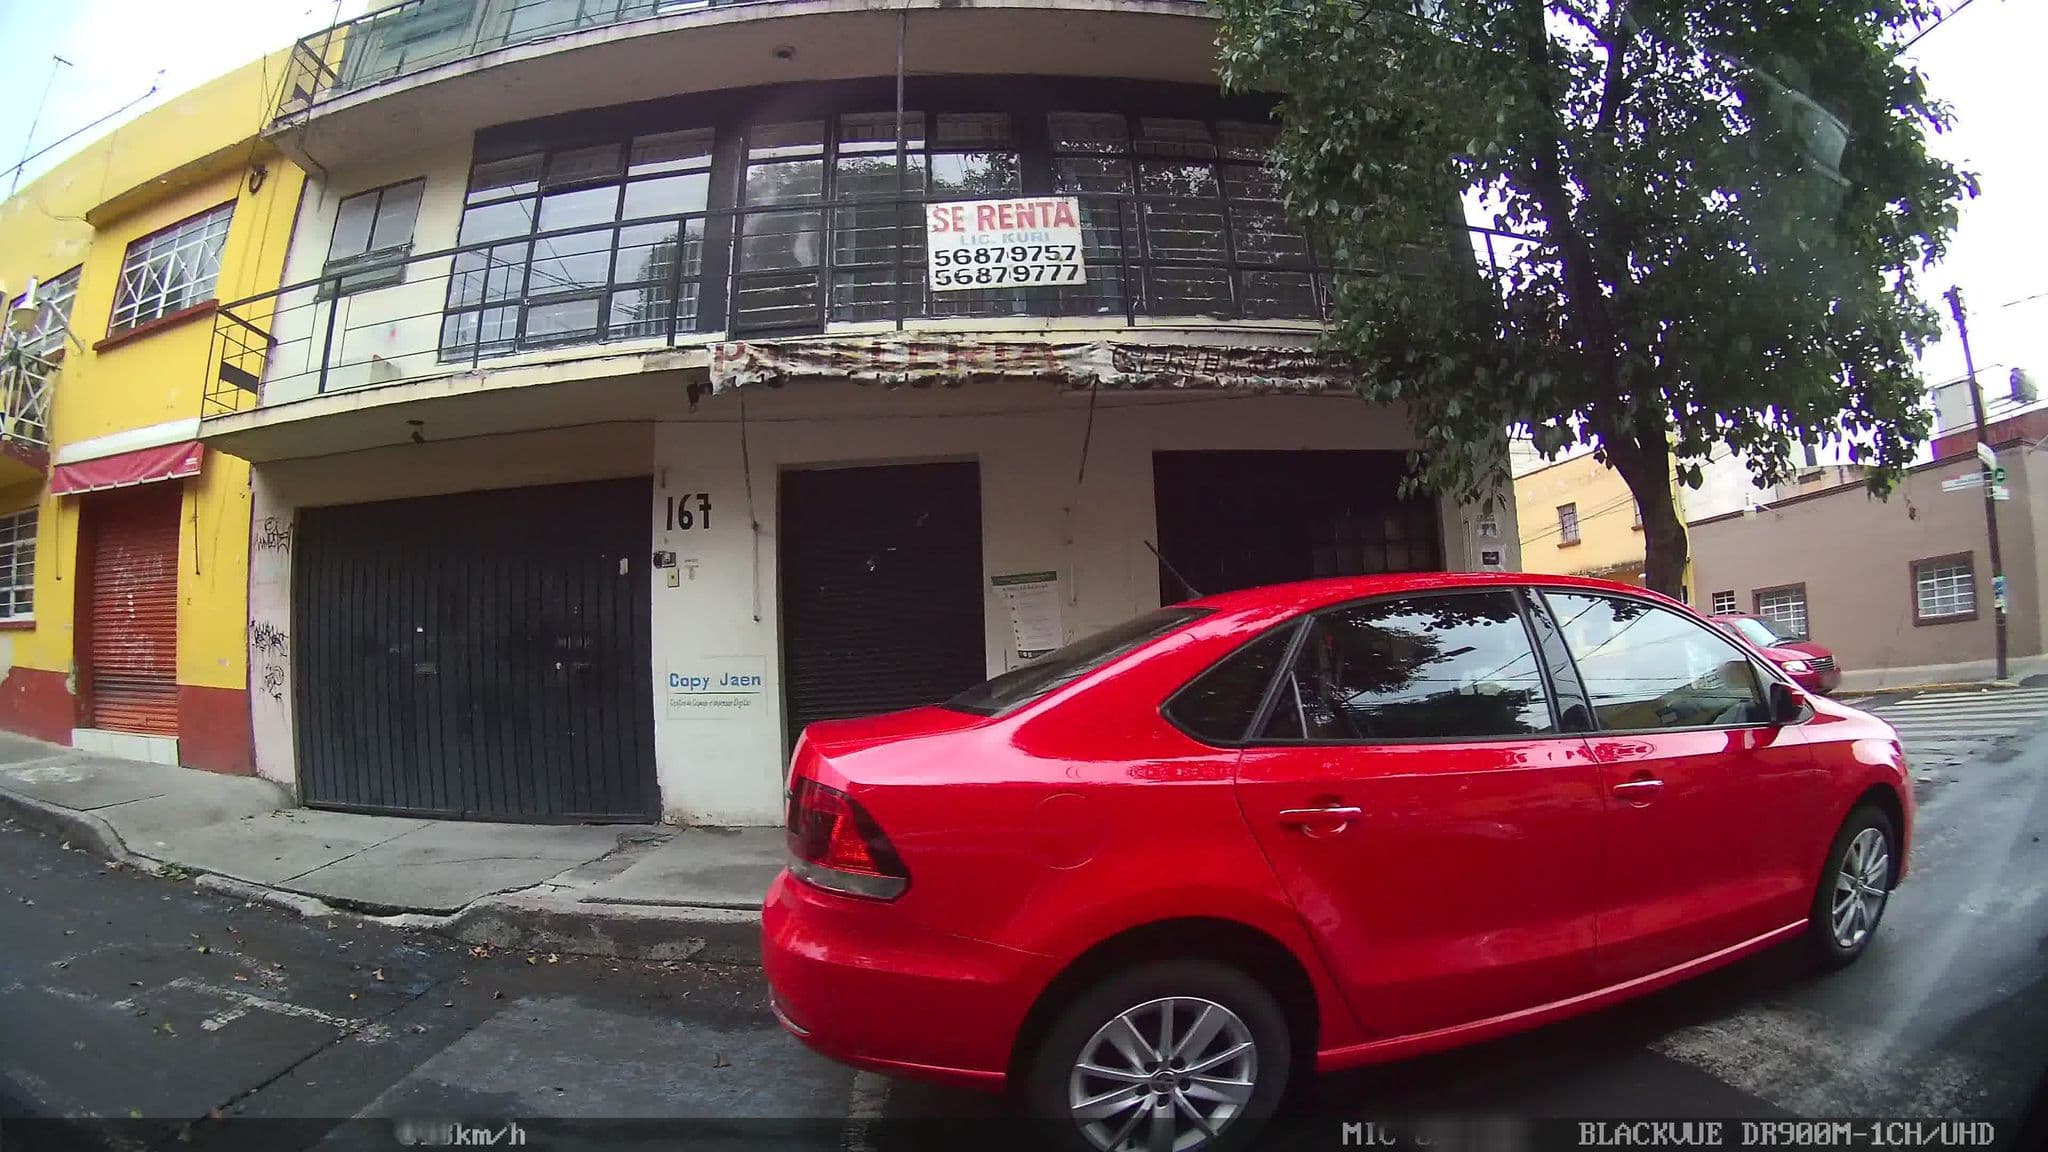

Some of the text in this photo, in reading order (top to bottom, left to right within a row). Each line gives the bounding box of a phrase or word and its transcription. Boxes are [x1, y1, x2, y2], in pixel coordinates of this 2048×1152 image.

[932, 202, 1076, 233] SE RENTA
[961, 232, 1050, 246] LIC. KURI
[666, 493, 712, 531] 167
[669, 672, 761, 691] Copy Jaen
